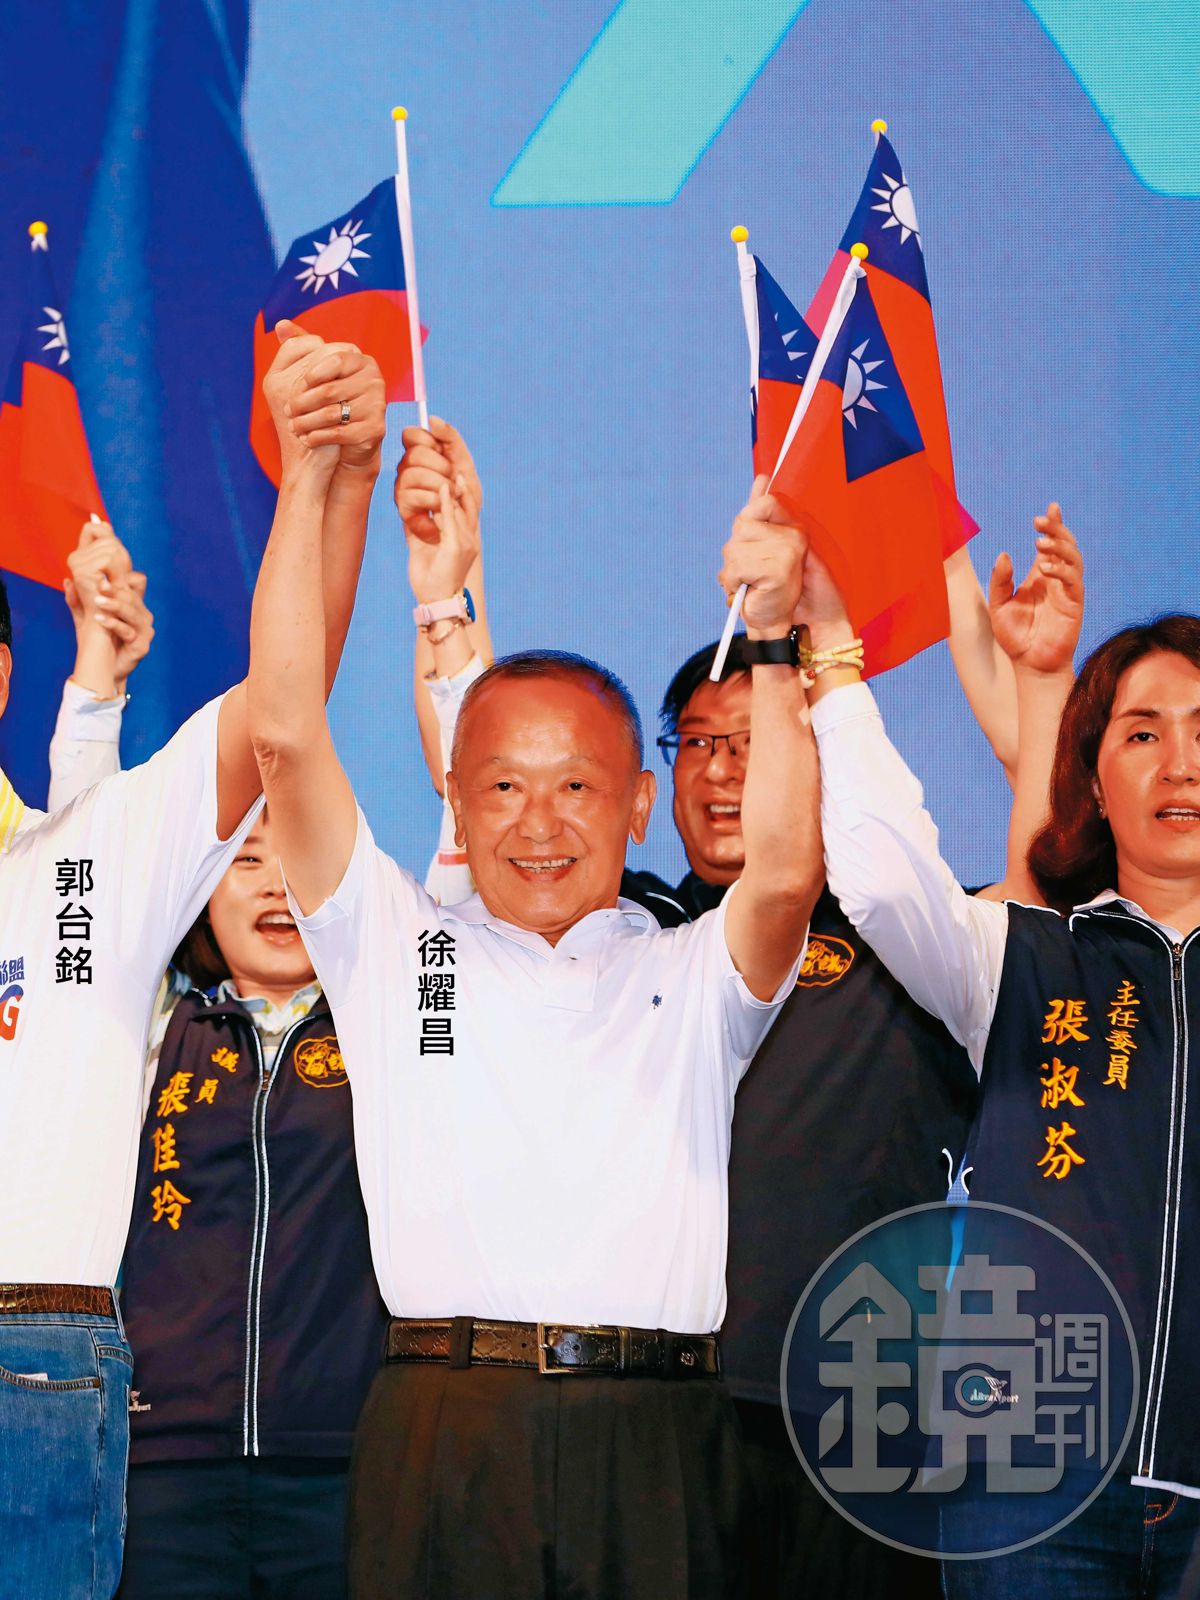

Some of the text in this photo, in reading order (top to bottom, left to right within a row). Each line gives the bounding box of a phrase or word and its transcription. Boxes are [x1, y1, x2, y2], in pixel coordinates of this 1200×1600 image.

[1036, 998, 1091, 1181] 張淑芬
[1102, 980, 1142, 1091] 主任委員
